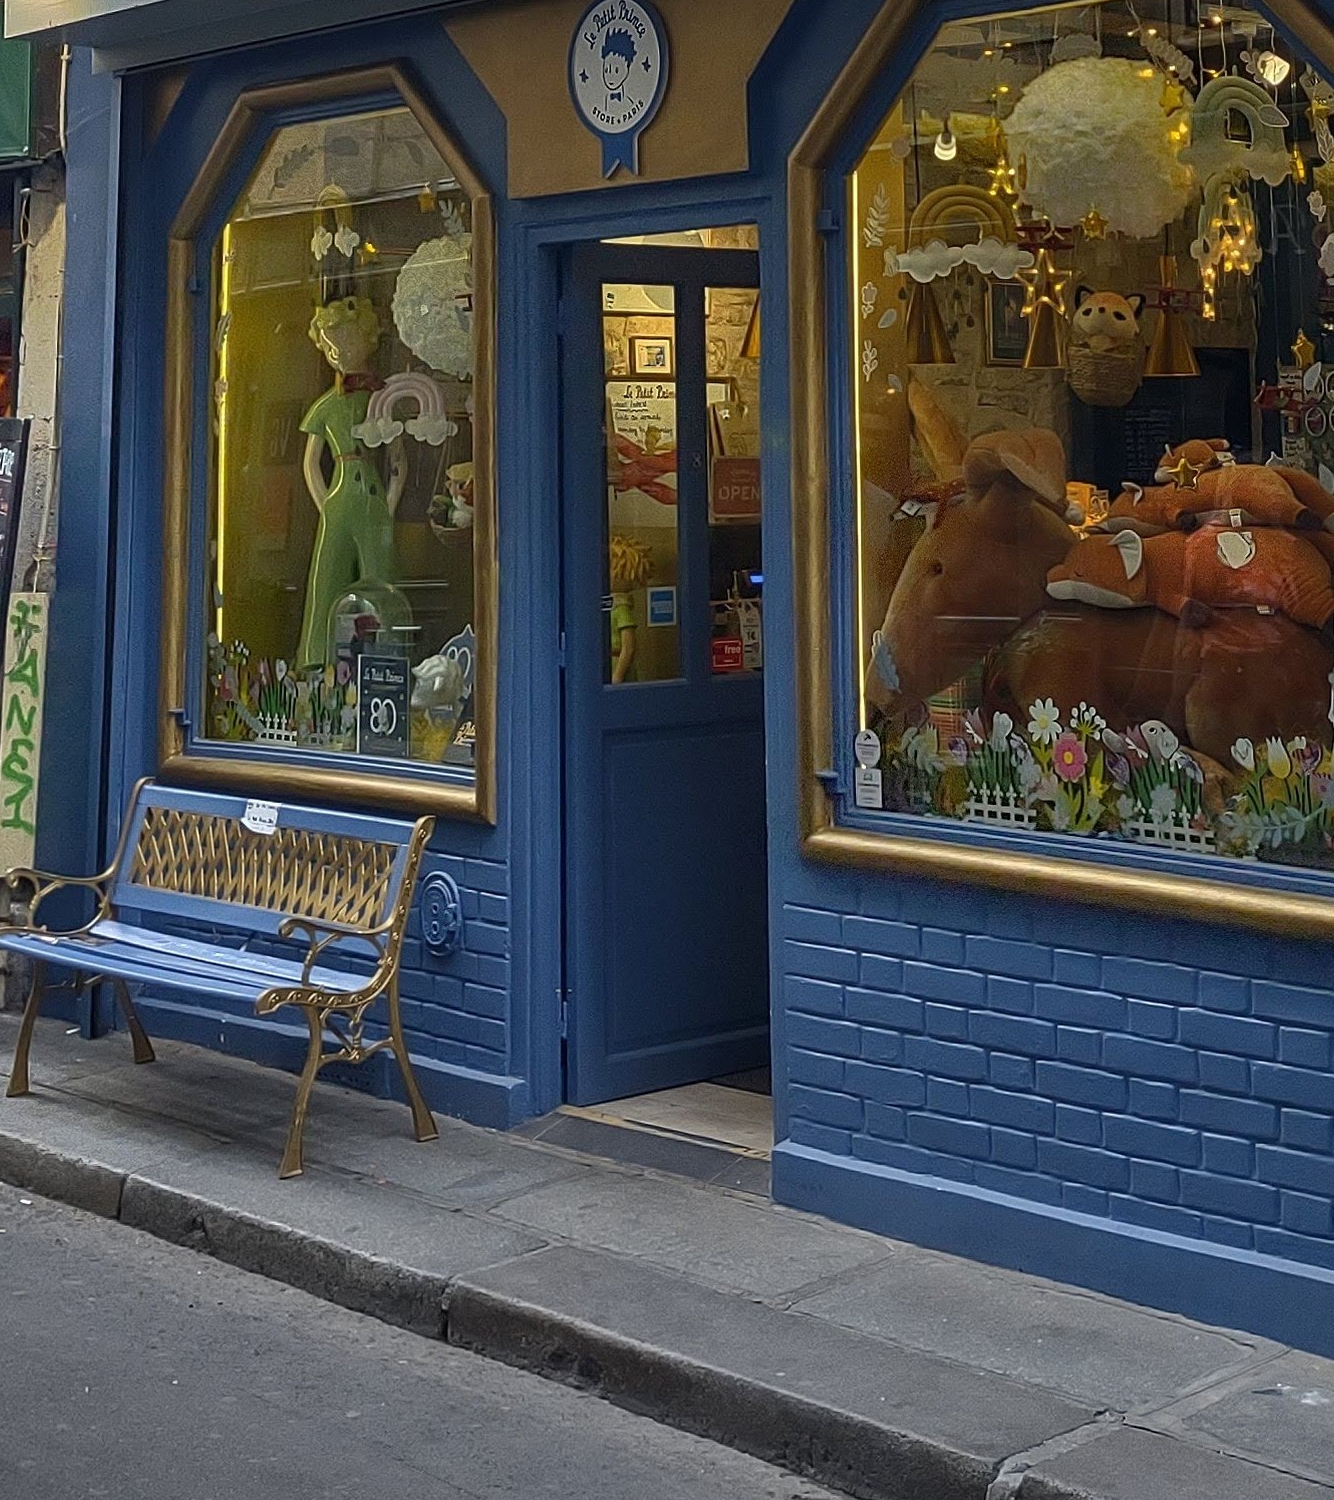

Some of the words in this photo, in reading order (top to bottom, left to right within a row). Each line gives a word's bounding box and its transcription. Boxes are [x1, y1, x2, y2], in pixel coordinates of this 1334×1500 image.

[583, 31, 596, 50] Le
[592, 4, 616, 33] Petit
[618, 0, 646, 39] Prince
[592, 105, 615, 125] STORE
[622, 99, 644, 123] PARIS
